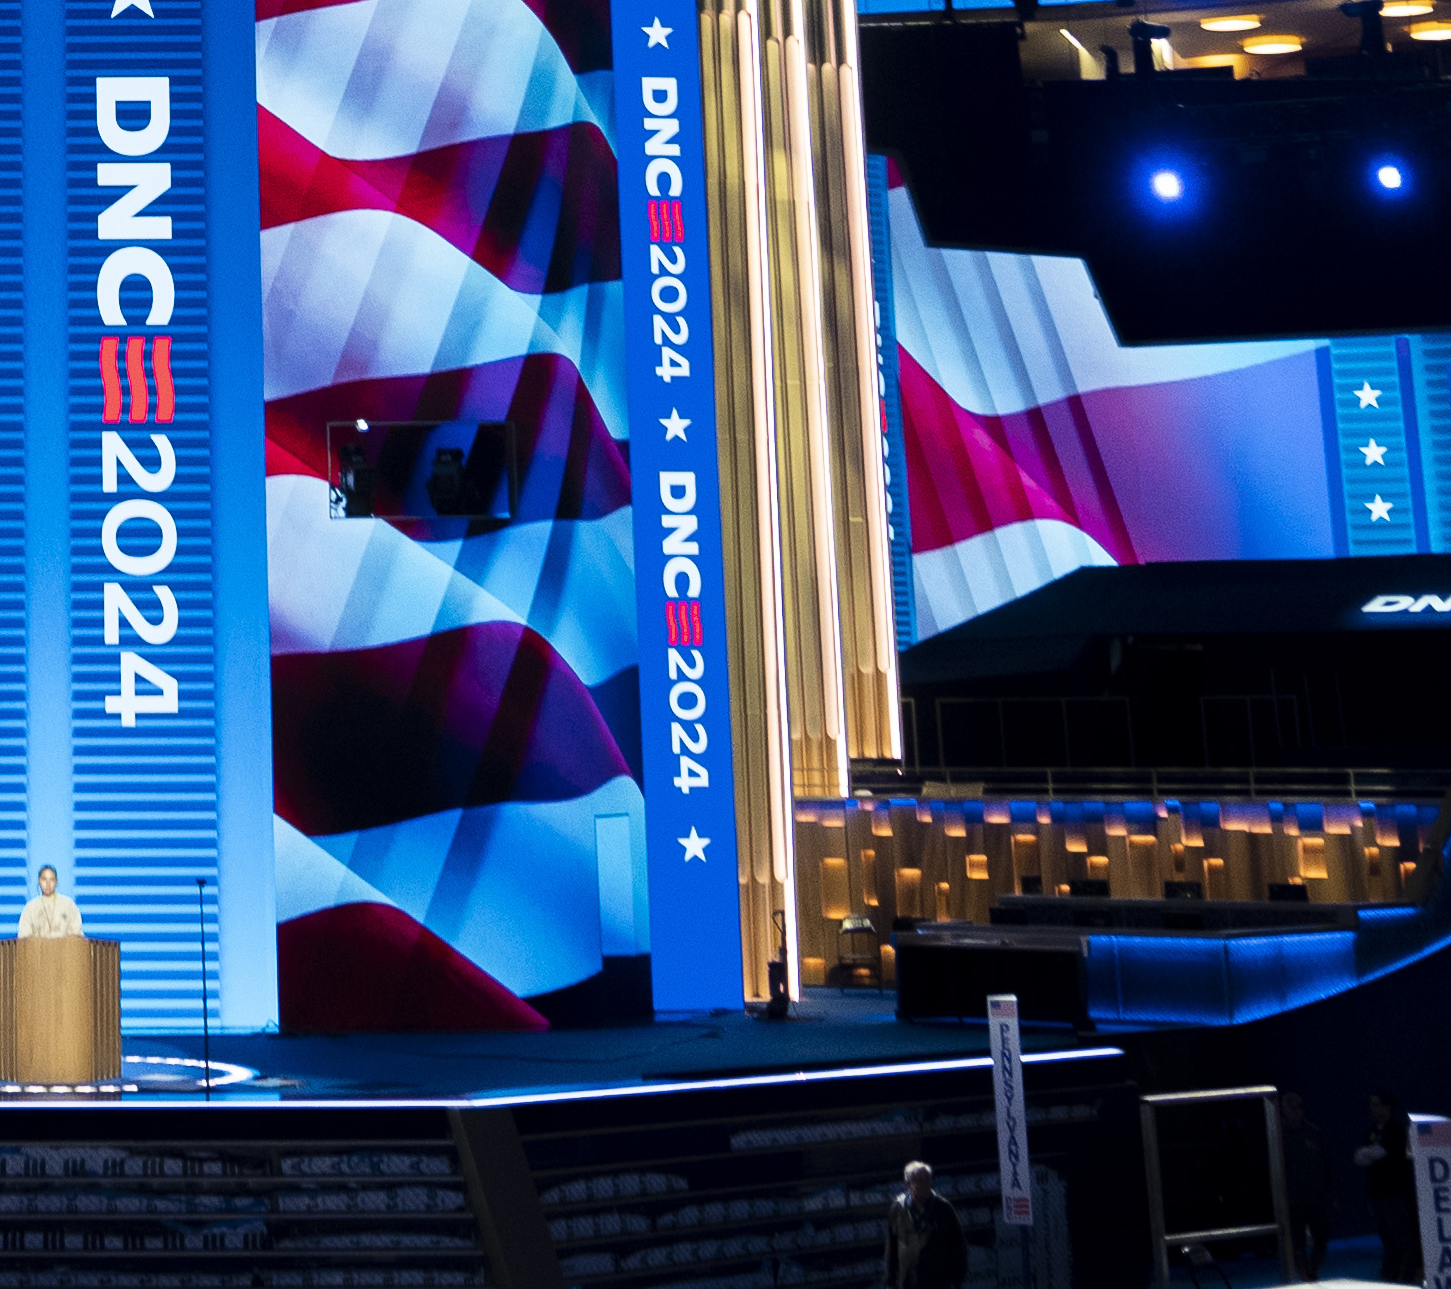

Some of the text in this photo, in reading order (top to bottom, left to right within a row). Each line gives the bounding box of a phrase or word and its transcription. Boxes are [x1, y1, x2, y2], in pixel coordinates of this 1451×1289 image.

[641, 75, 690, 384] DNC 2024
[96, 76, 179, 729] DNC 2024
[659, 470, 710, 795] DNC 2024
[1000, 1023, 1021, 1190] PENNSYLVANIA
